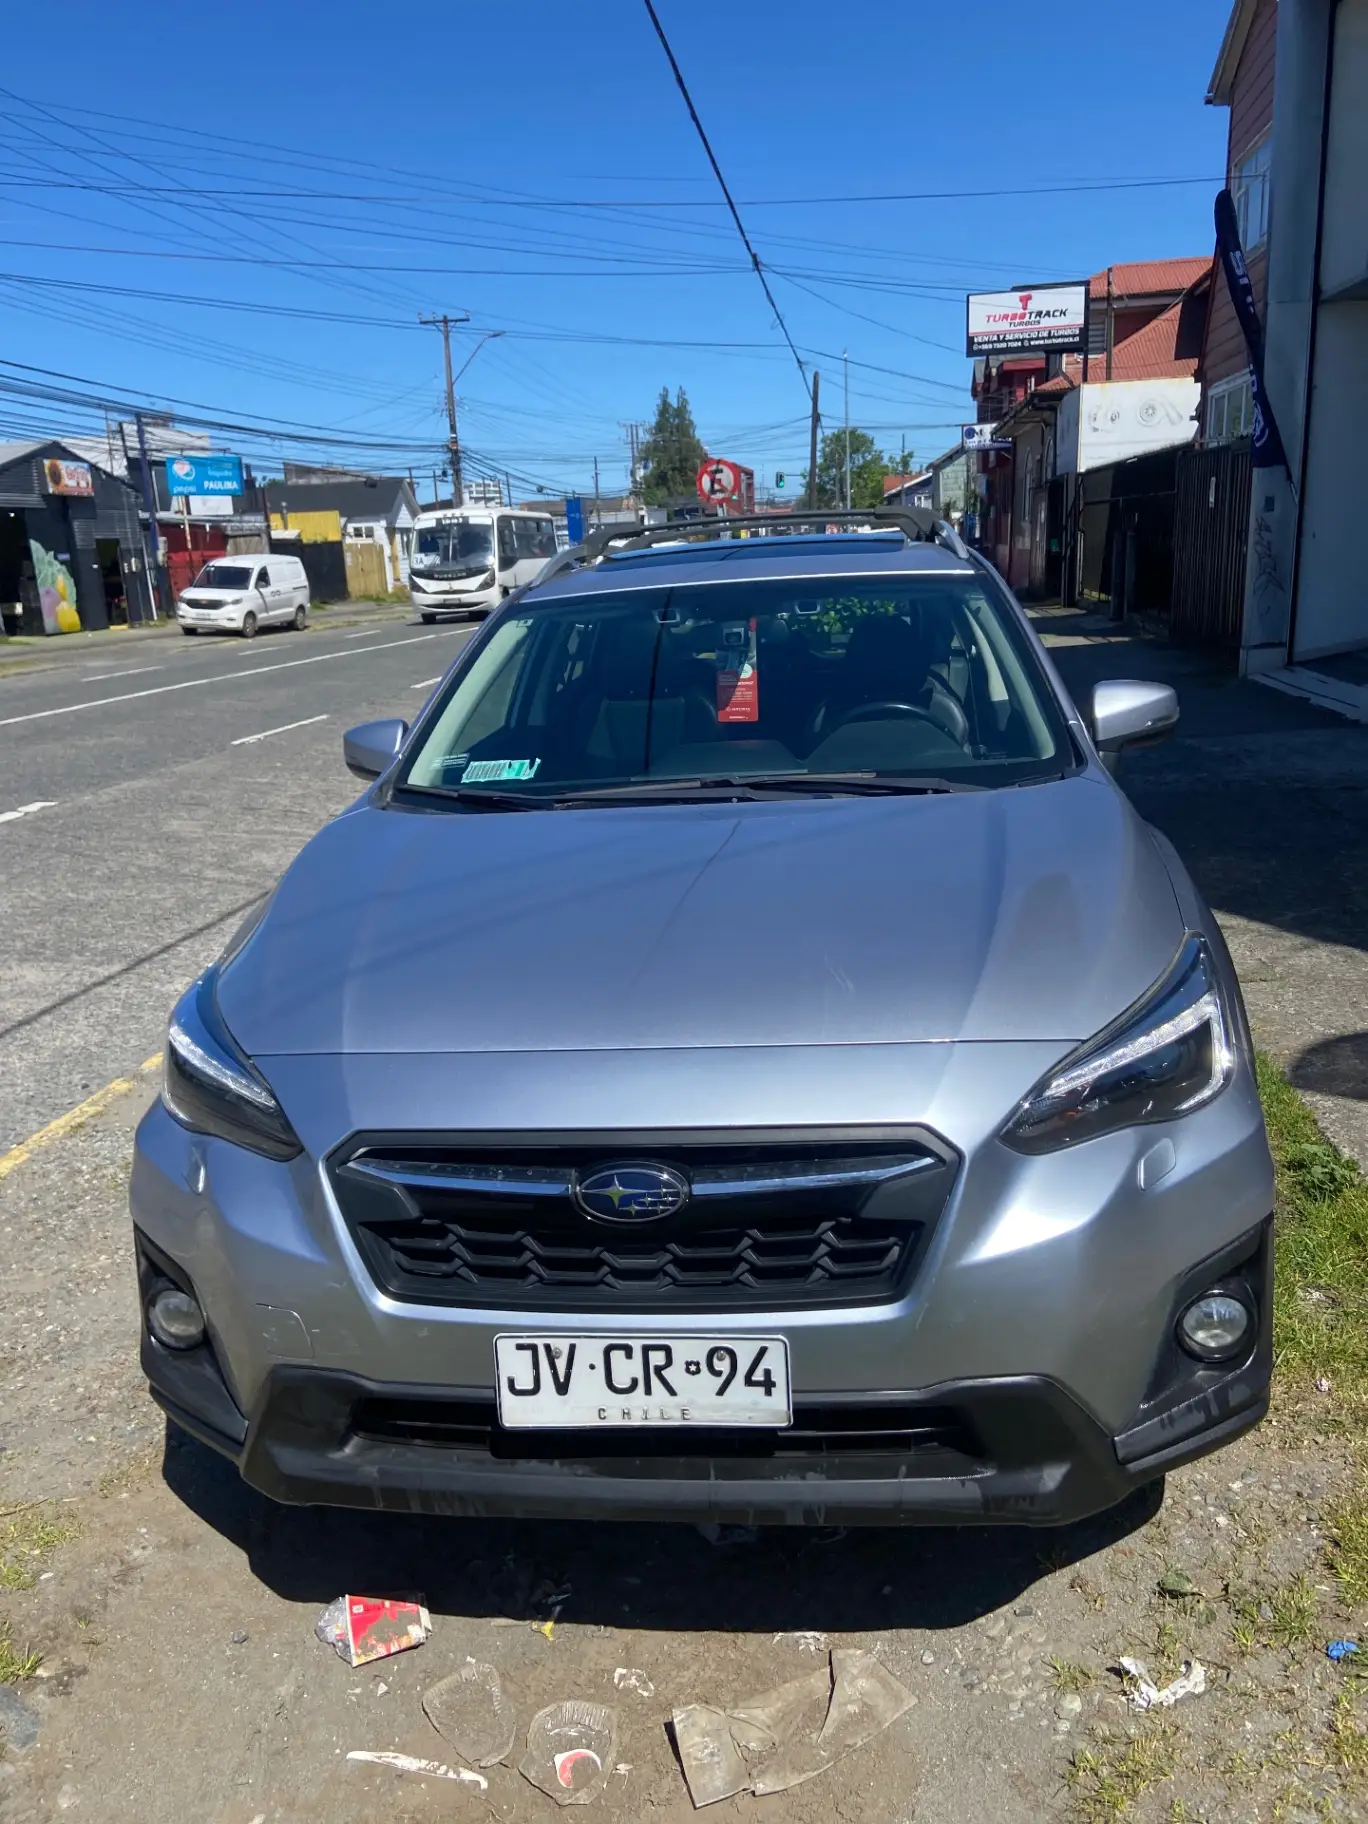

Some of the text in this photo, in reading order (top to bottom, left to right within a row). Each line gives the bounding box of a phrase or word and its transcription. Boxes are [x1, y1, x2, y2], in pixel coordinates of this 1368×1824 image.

[1009, 320, 1041, 328] TURBOS
[974, 335, 998, 343] VENTA
[1004, 331, 1038, 341] SERVICIO
[1038, 330, 1049, 338] DE
[1050, 327, 1080, 337] TURBOS
[172, 485, 197, 494] pepsi
[203, 480, 239, 490] PAULINA
[597, 1406, 692, 1421] CHILE
